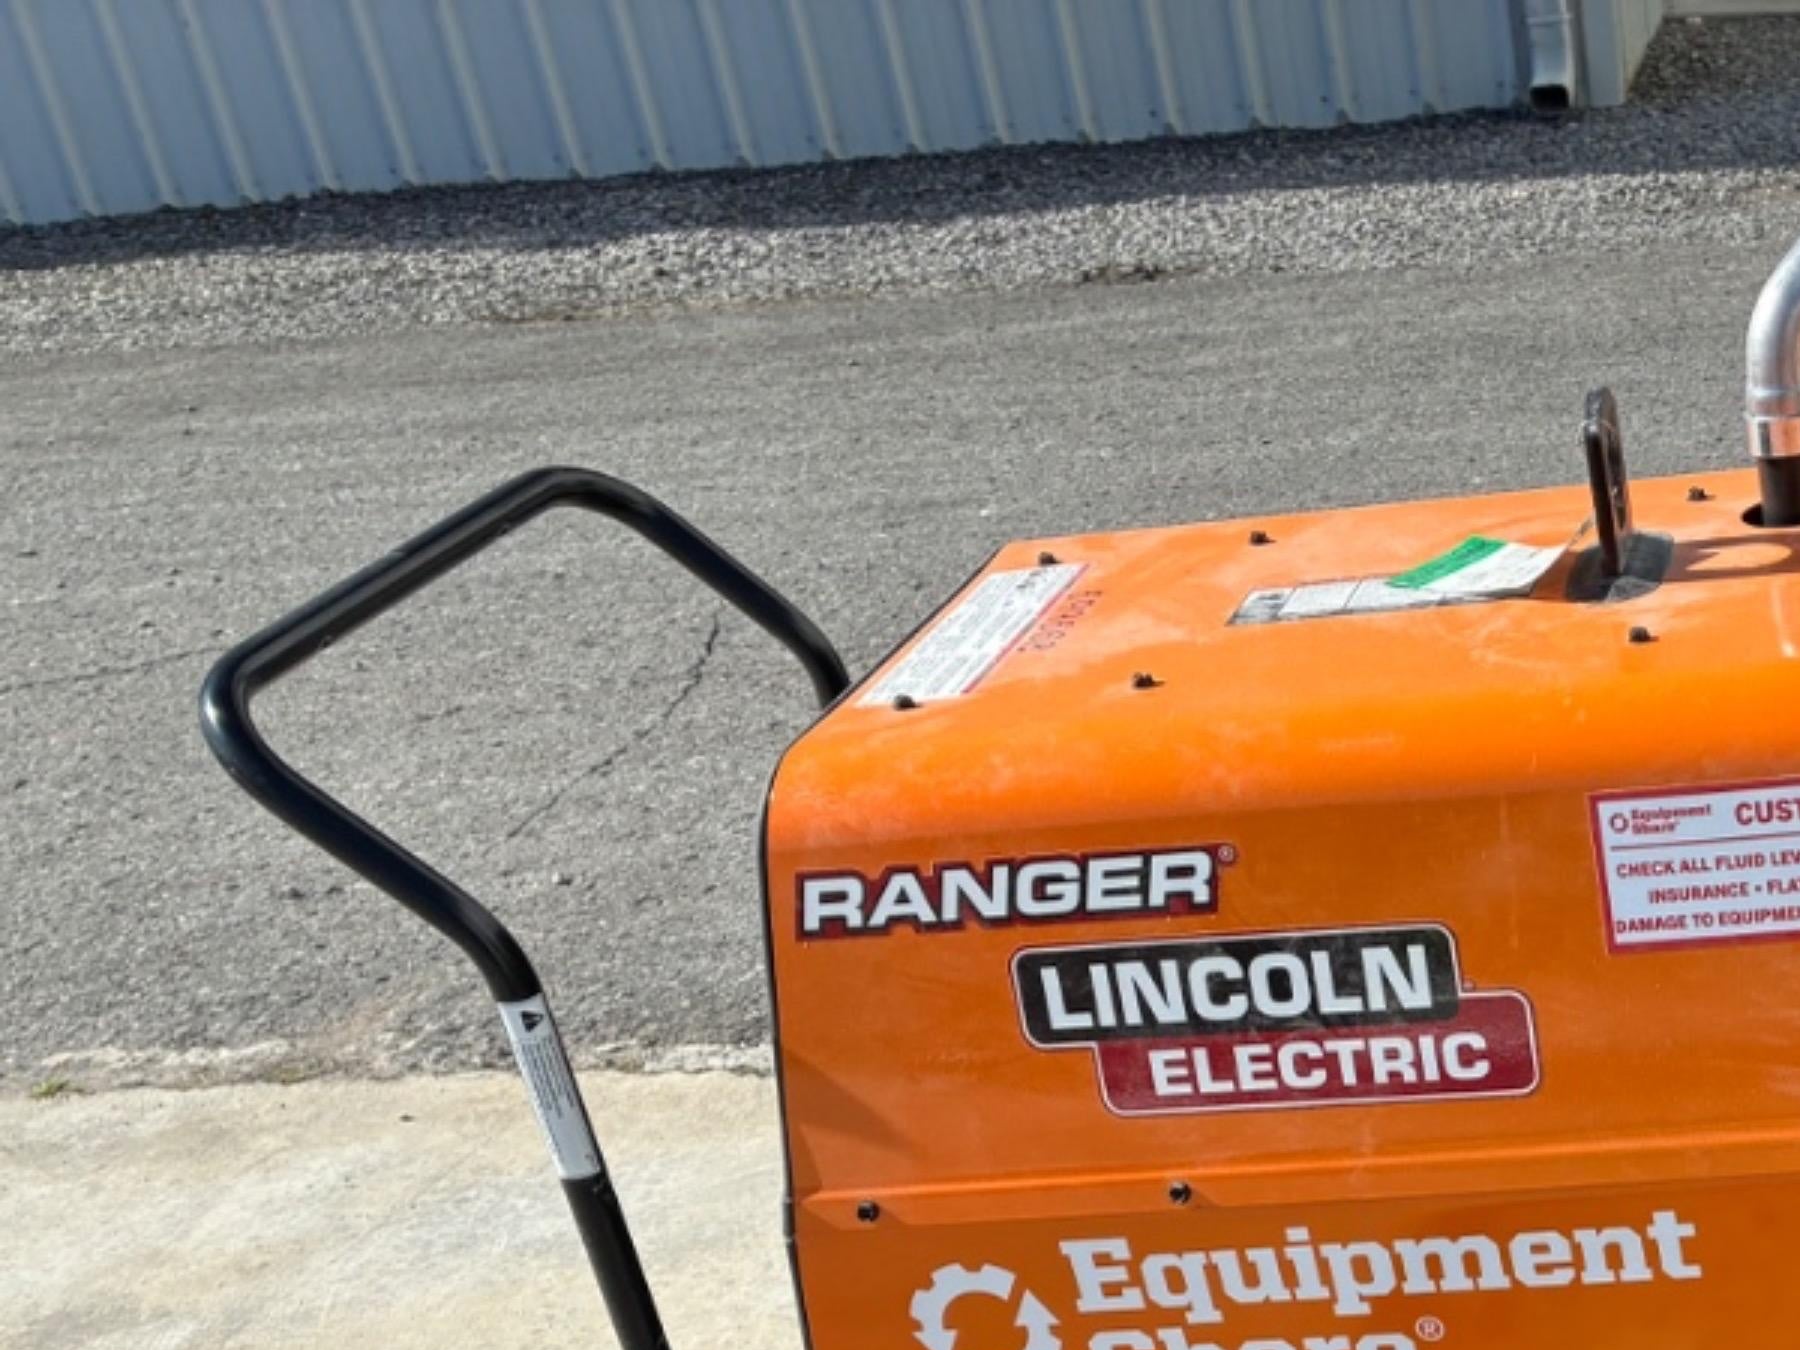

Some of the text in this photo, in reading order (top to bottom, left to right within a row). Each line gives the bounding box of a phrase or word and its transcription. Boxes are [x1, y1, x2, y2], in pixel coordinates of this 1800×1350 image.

[1616, 862, 1675, 879] CHECK
[1679, 857, 1712, 874] ALL
[1715, 852, 1766, 872] FLUID
[1649, 881, 1750, 904] INSURANCE
[1616, 914, 1688, 934] DAMAGE
[1692, 912, 1714, 928] TO
[1038, 942, 1434, 1032] LINCOLN
[1146, 1030, 1492, 1097] ELECTRIC
[1058, 1210, 1702, 1324] Equipment
